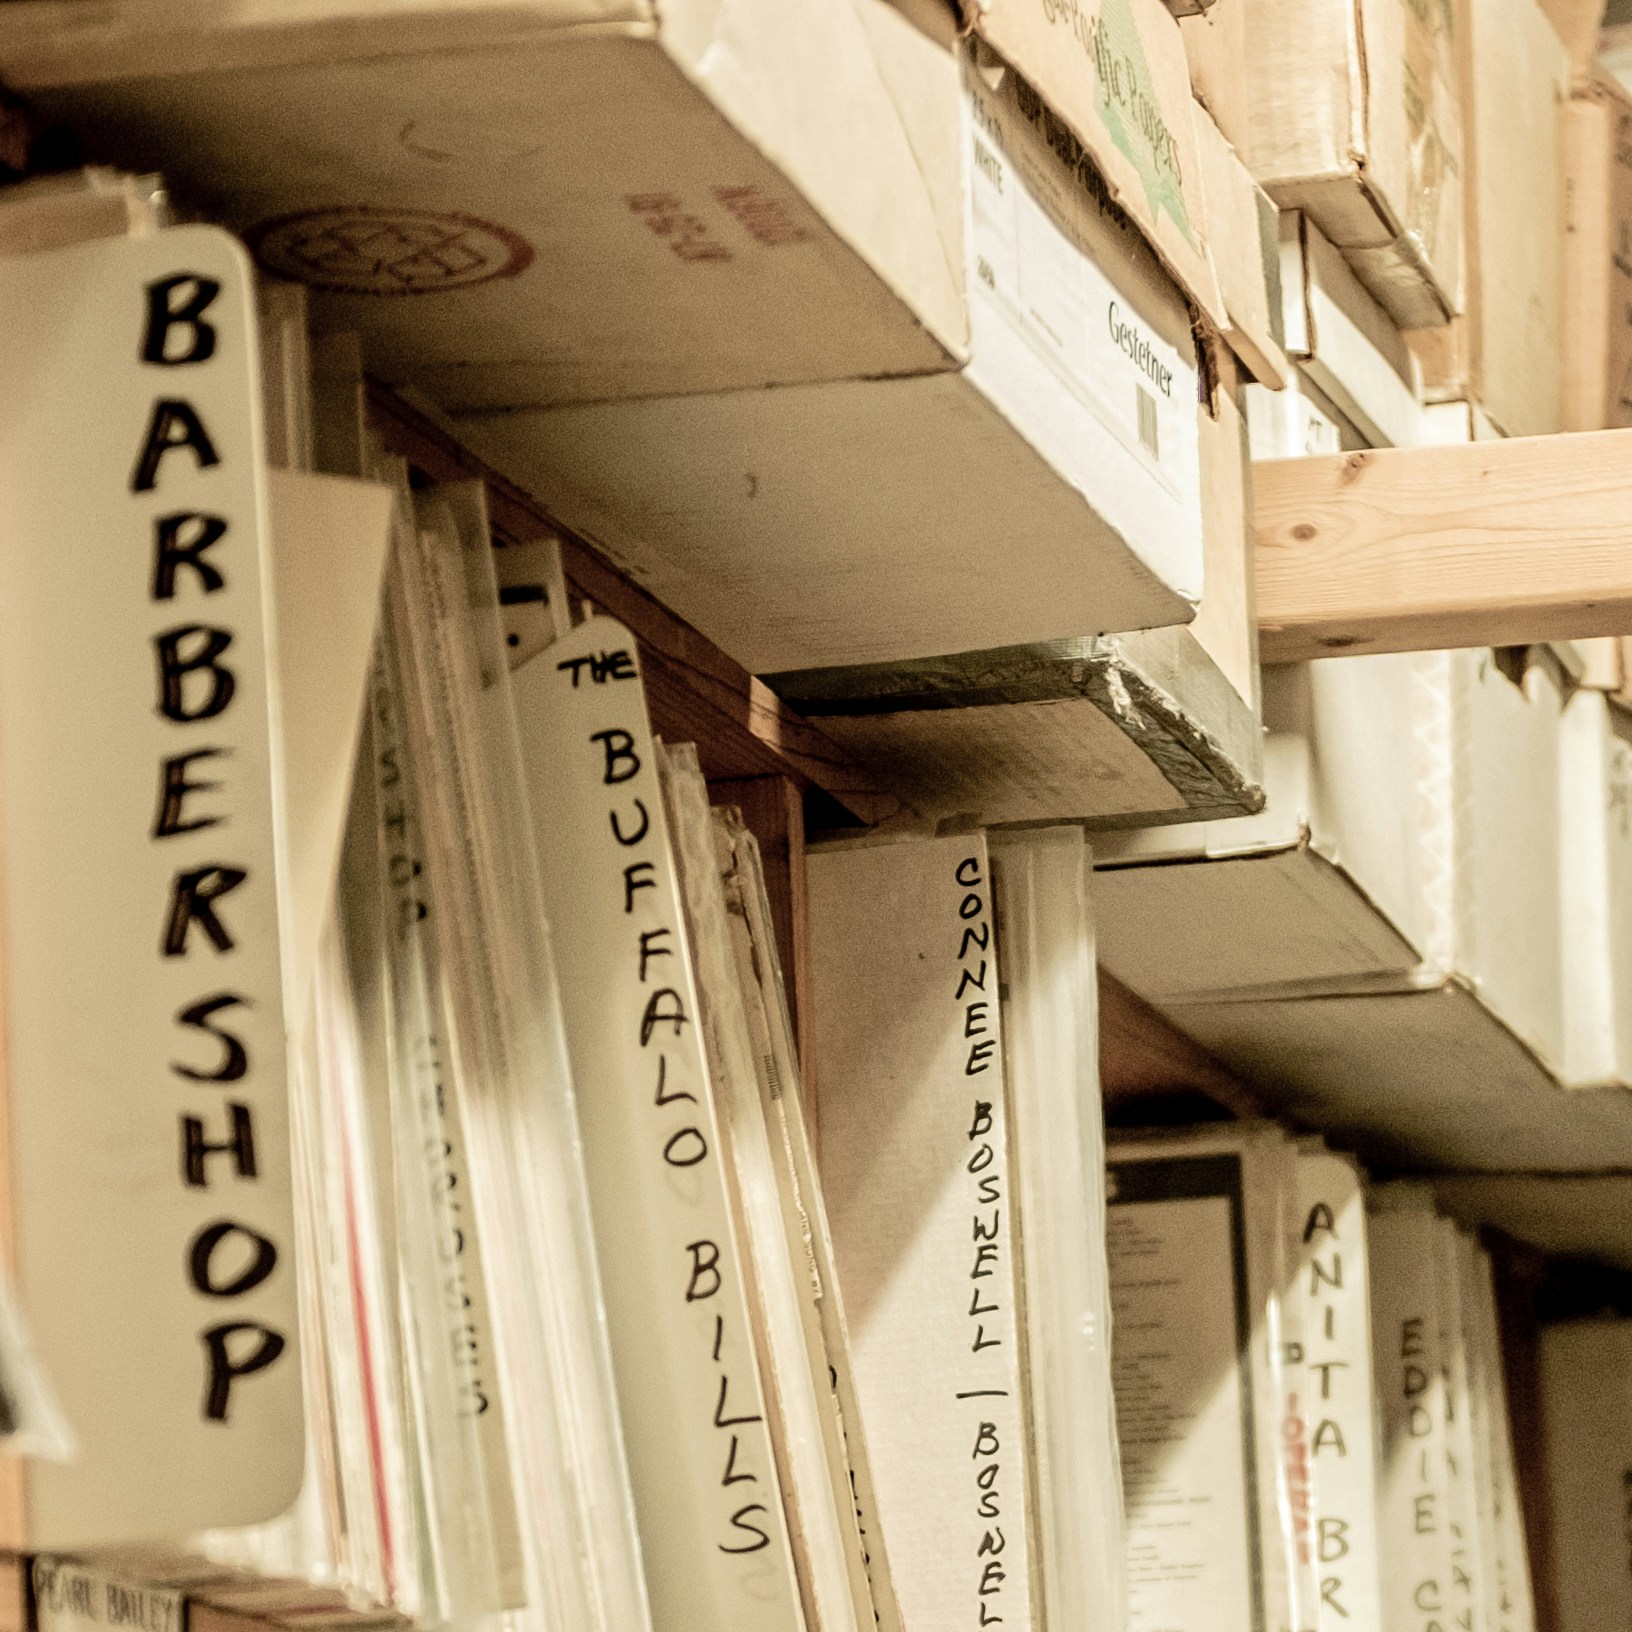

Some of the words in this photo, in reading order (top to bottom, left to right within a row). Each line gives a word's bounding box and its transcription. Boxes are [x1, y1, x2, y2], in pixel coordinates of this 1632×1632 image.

[1108, 300, 1173, 397] Gestetner
[556, 649, 638, 690] THE
[130, 271, 286, 1424] BARBERSHOP
[590, 728, 709, 1168] BUFFALO
[955, 857, 996, 1077] CONNEE
[966, 1100, 1001, 1354] BOSWELL
[1302, 1202, 1350, 1459] ANITA
[685, 1240, 770, 1555] BILLS
[1400, 1316, 1436, 1536] EDDIE
